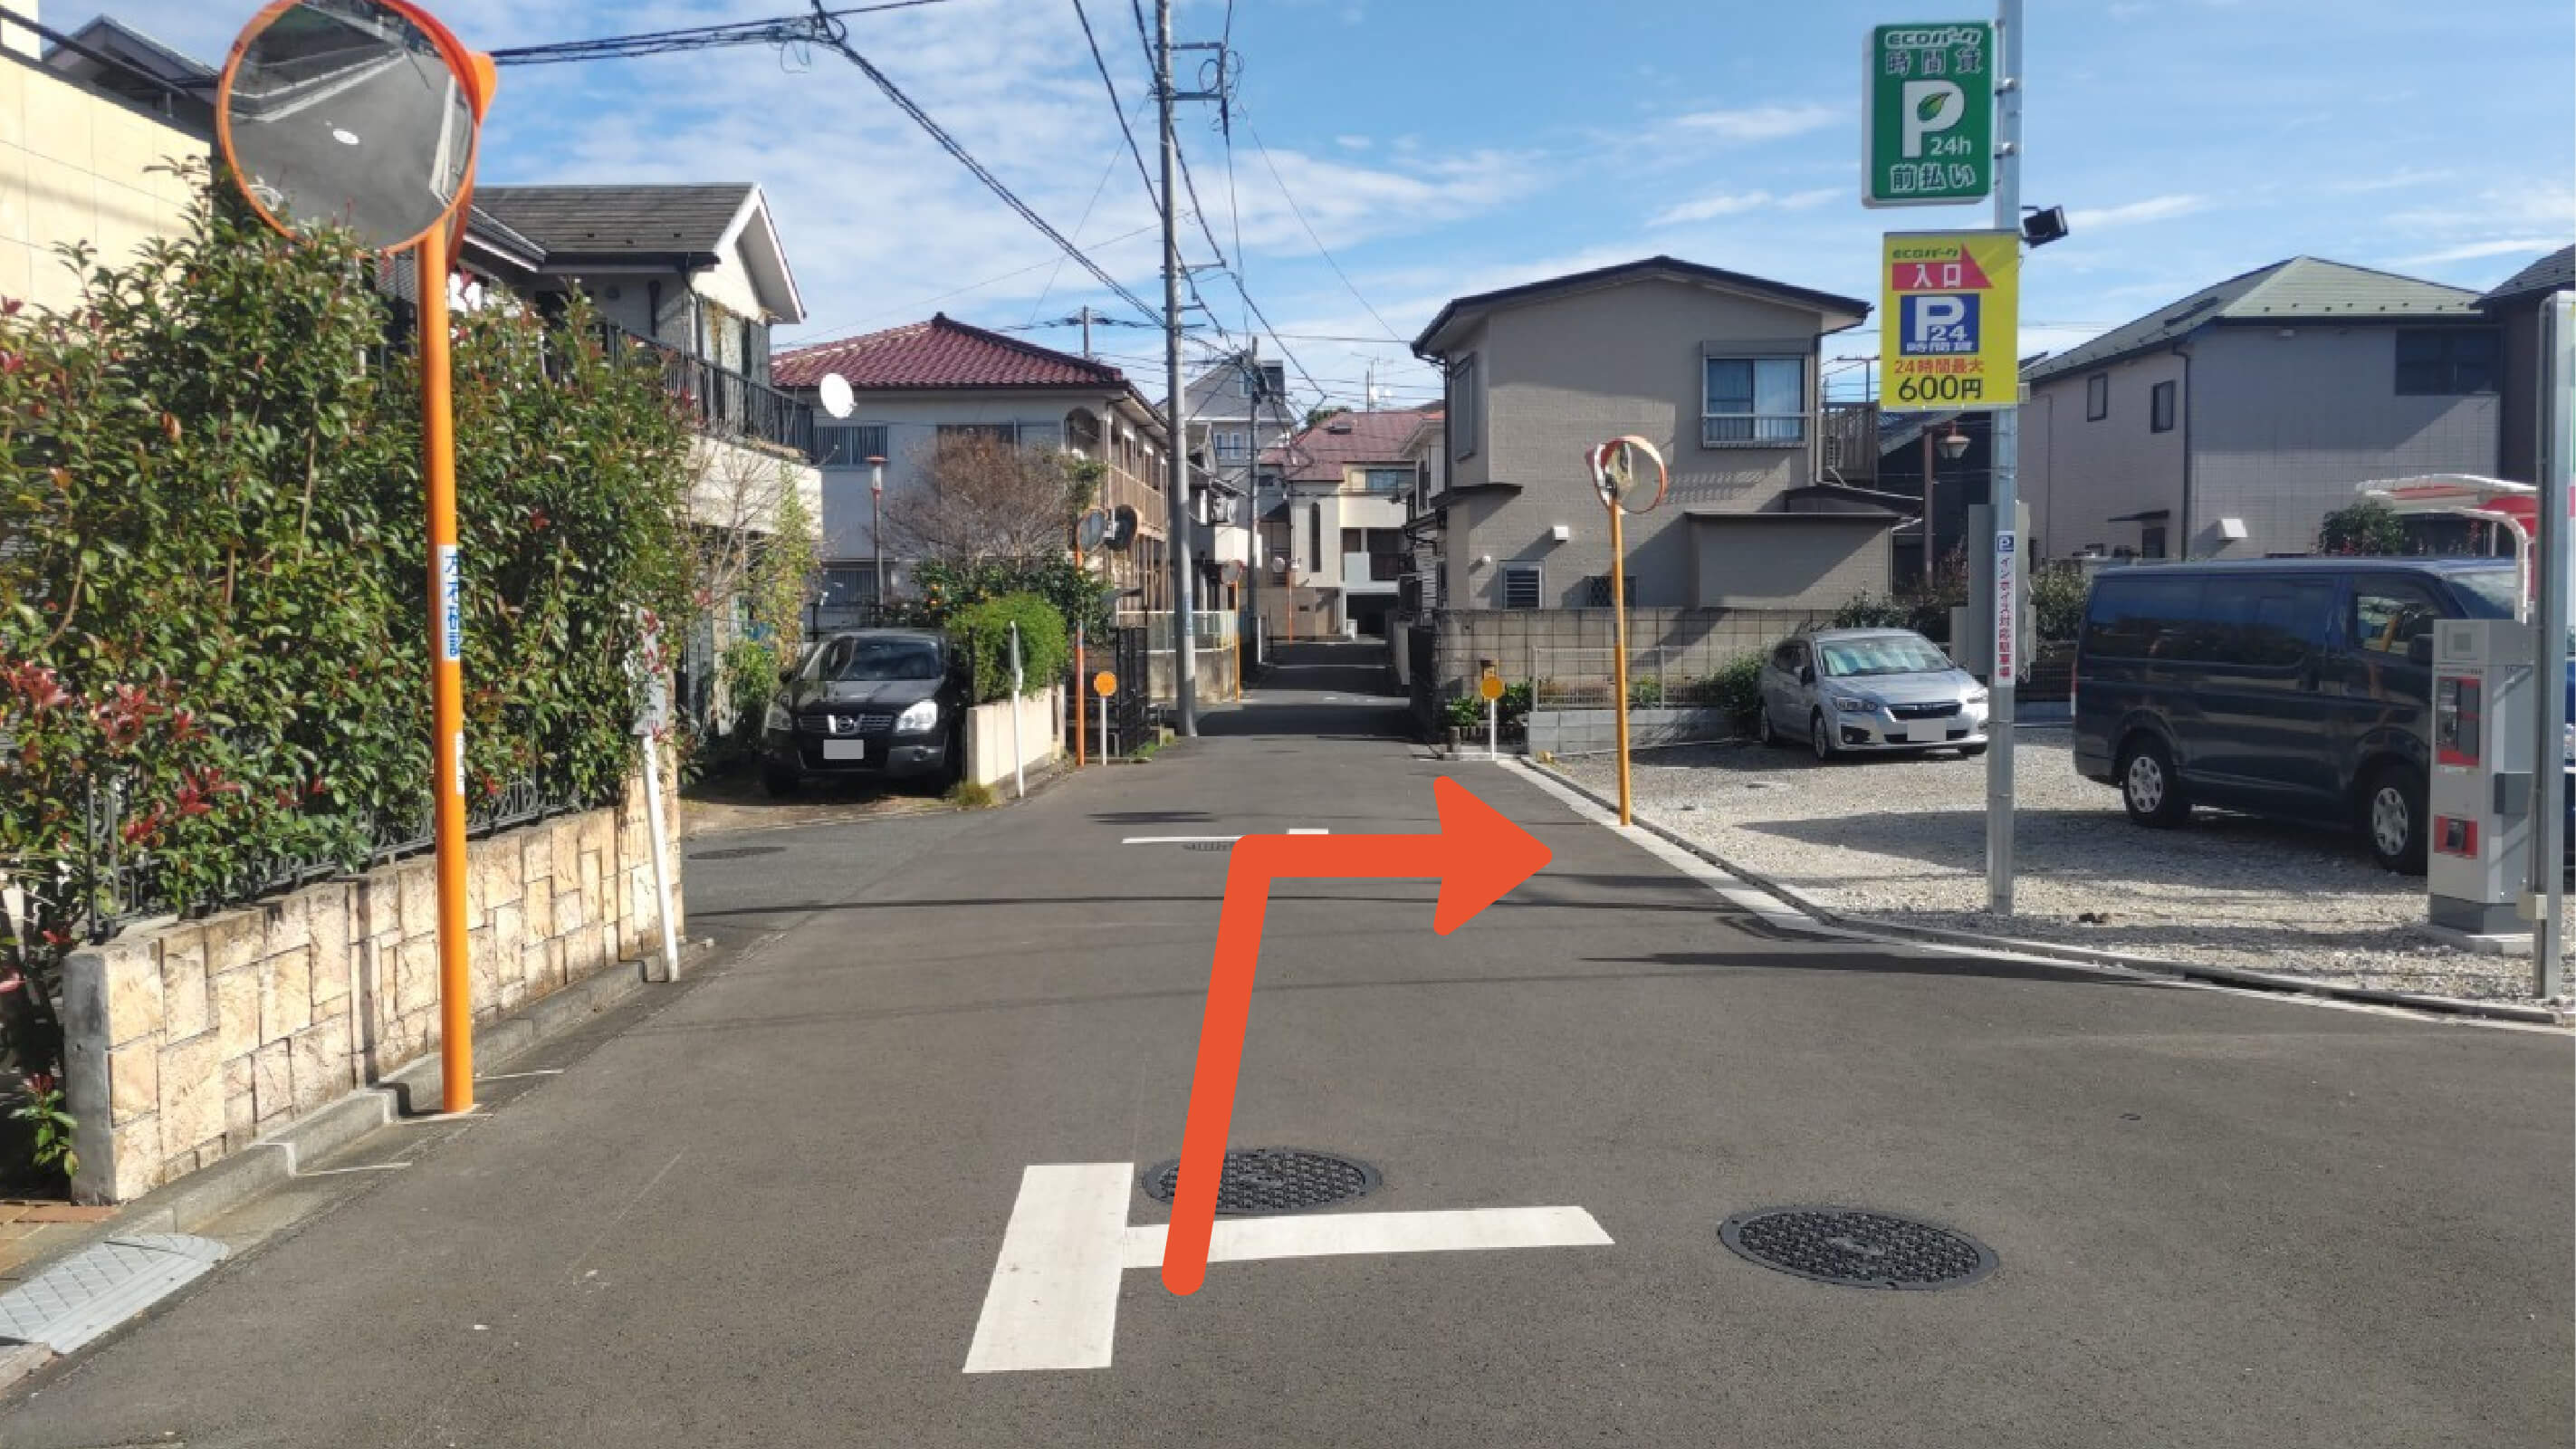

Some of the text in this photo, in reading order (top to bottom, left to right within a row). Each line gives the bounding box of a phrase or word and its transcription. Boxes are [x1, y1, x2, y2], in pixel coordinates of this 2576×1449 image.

[1885, 47, 1983, 74] 時間貸
[1902, 80, 1965, 158] P
[1930, 137, 1971, 156] 24h
[1890, 162, 1977, 193] 前払い
[1913, 264, 1961, 288] 入口
[1915, 296, 1965, 341] P
[1930, 325, 1968, 341] 24
[1894, 358, 1984, 374] 24時間最大
[1899, 375, 1983, 402] 600円
